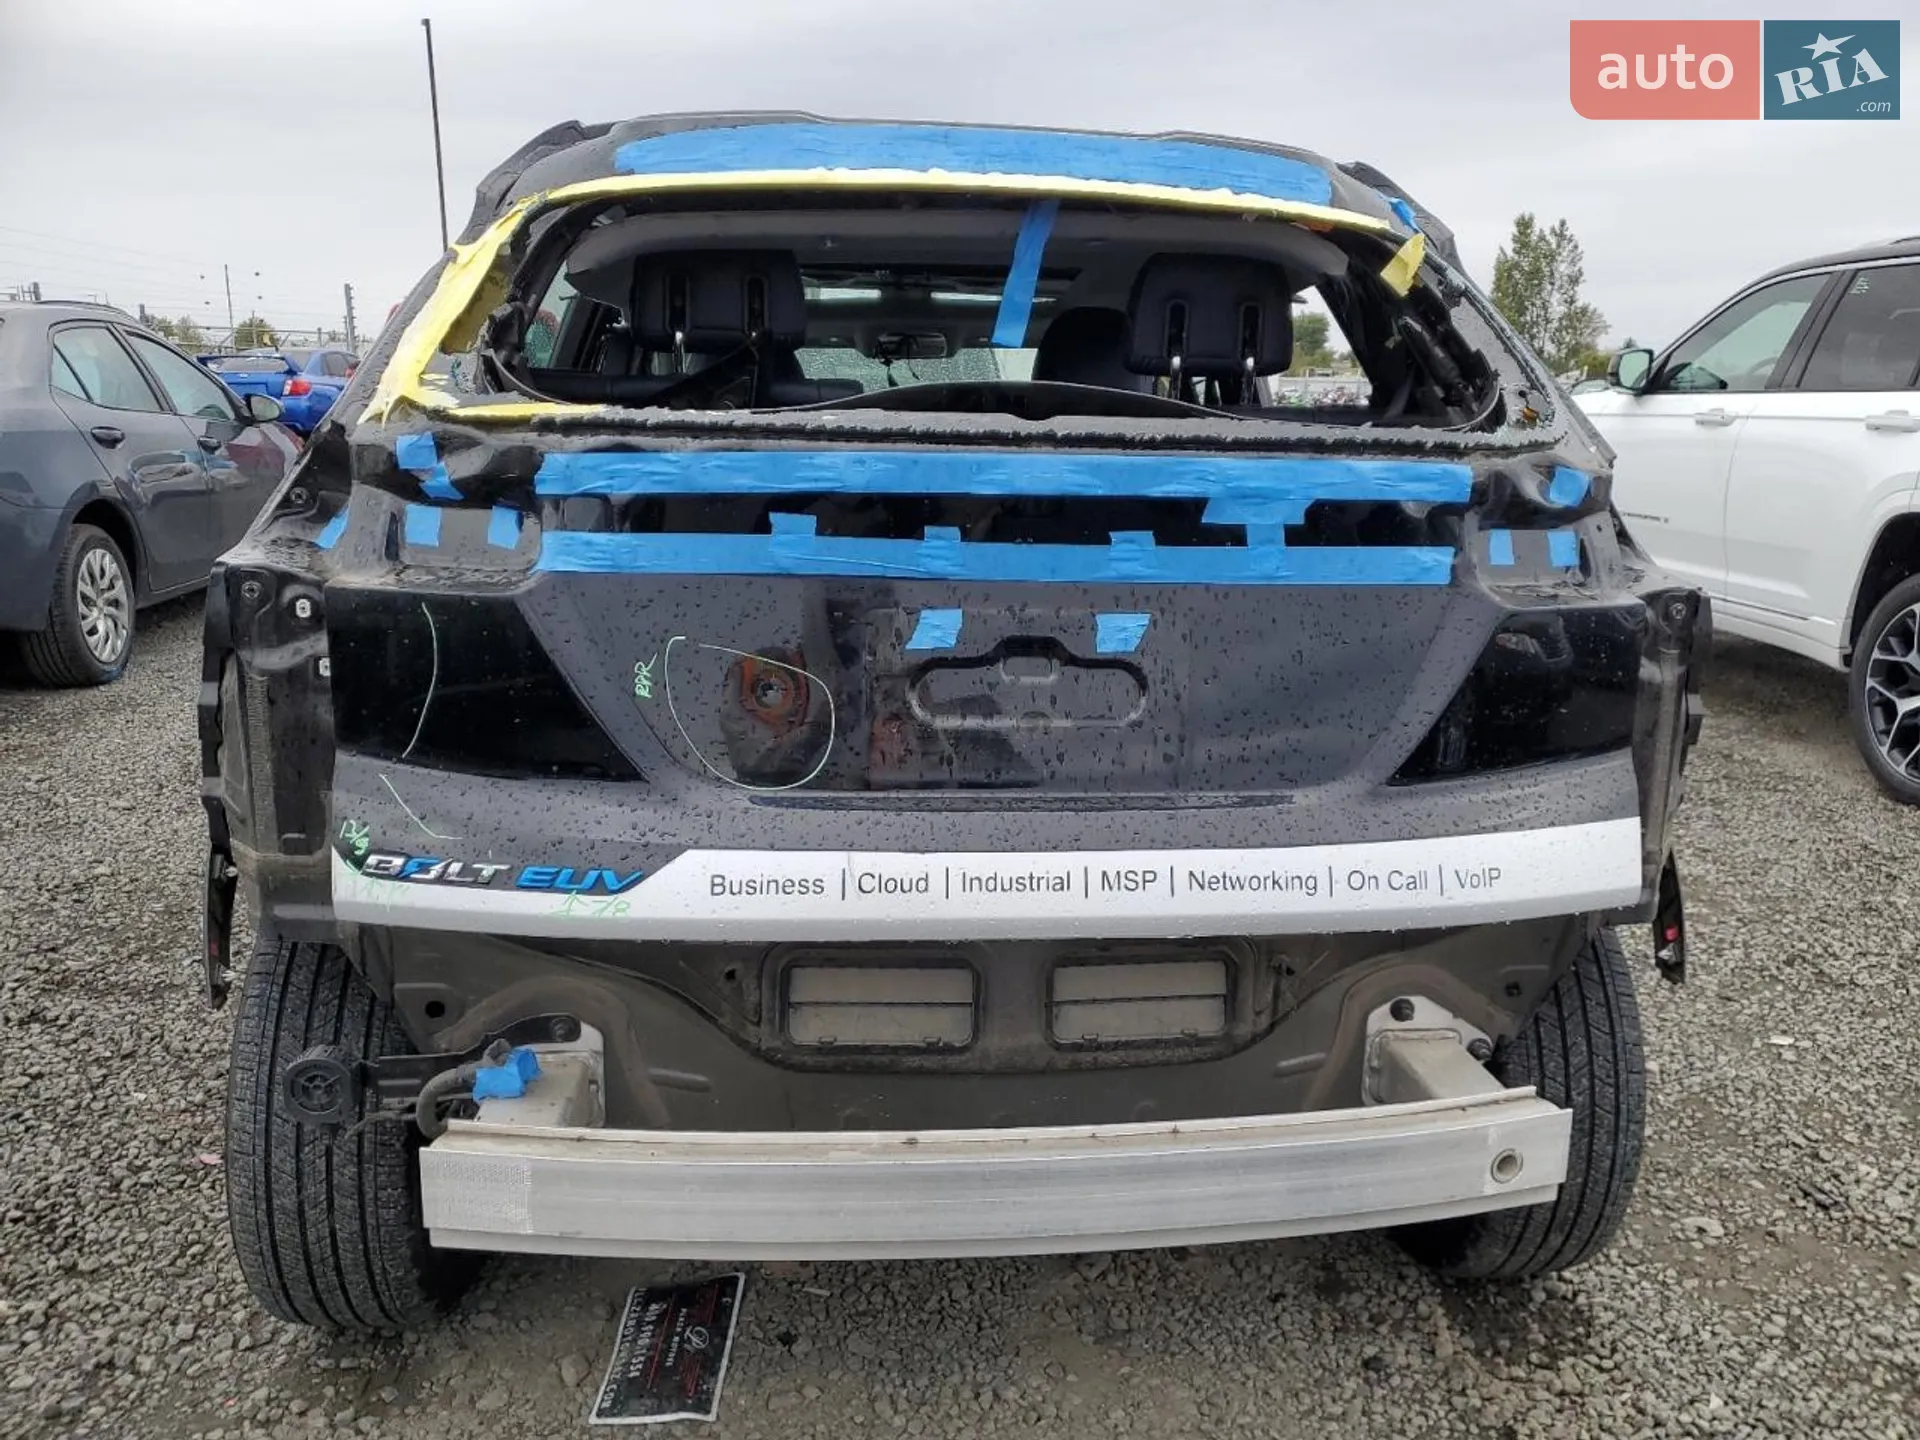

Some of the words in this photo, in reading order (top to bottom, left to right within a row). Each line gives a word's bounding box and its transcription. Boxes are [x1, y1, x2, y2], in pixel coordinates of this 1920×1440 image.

[360, 852, 511, 885] BOLT
[516, 865, 644, 894] EUV
[710, 873, 825, 896] Business
[857, 872, 930, 894] Cloud
[961, 870, 1071, 893] Industrial
[1101, 869, 1158, 892] MSP
[1188, 869, 1318, 896] Networking
[1347, 869, 1379, 892] On
[1388, 869, 1428, 892] Call
[1455, 867, 1502, 890] VoIP
